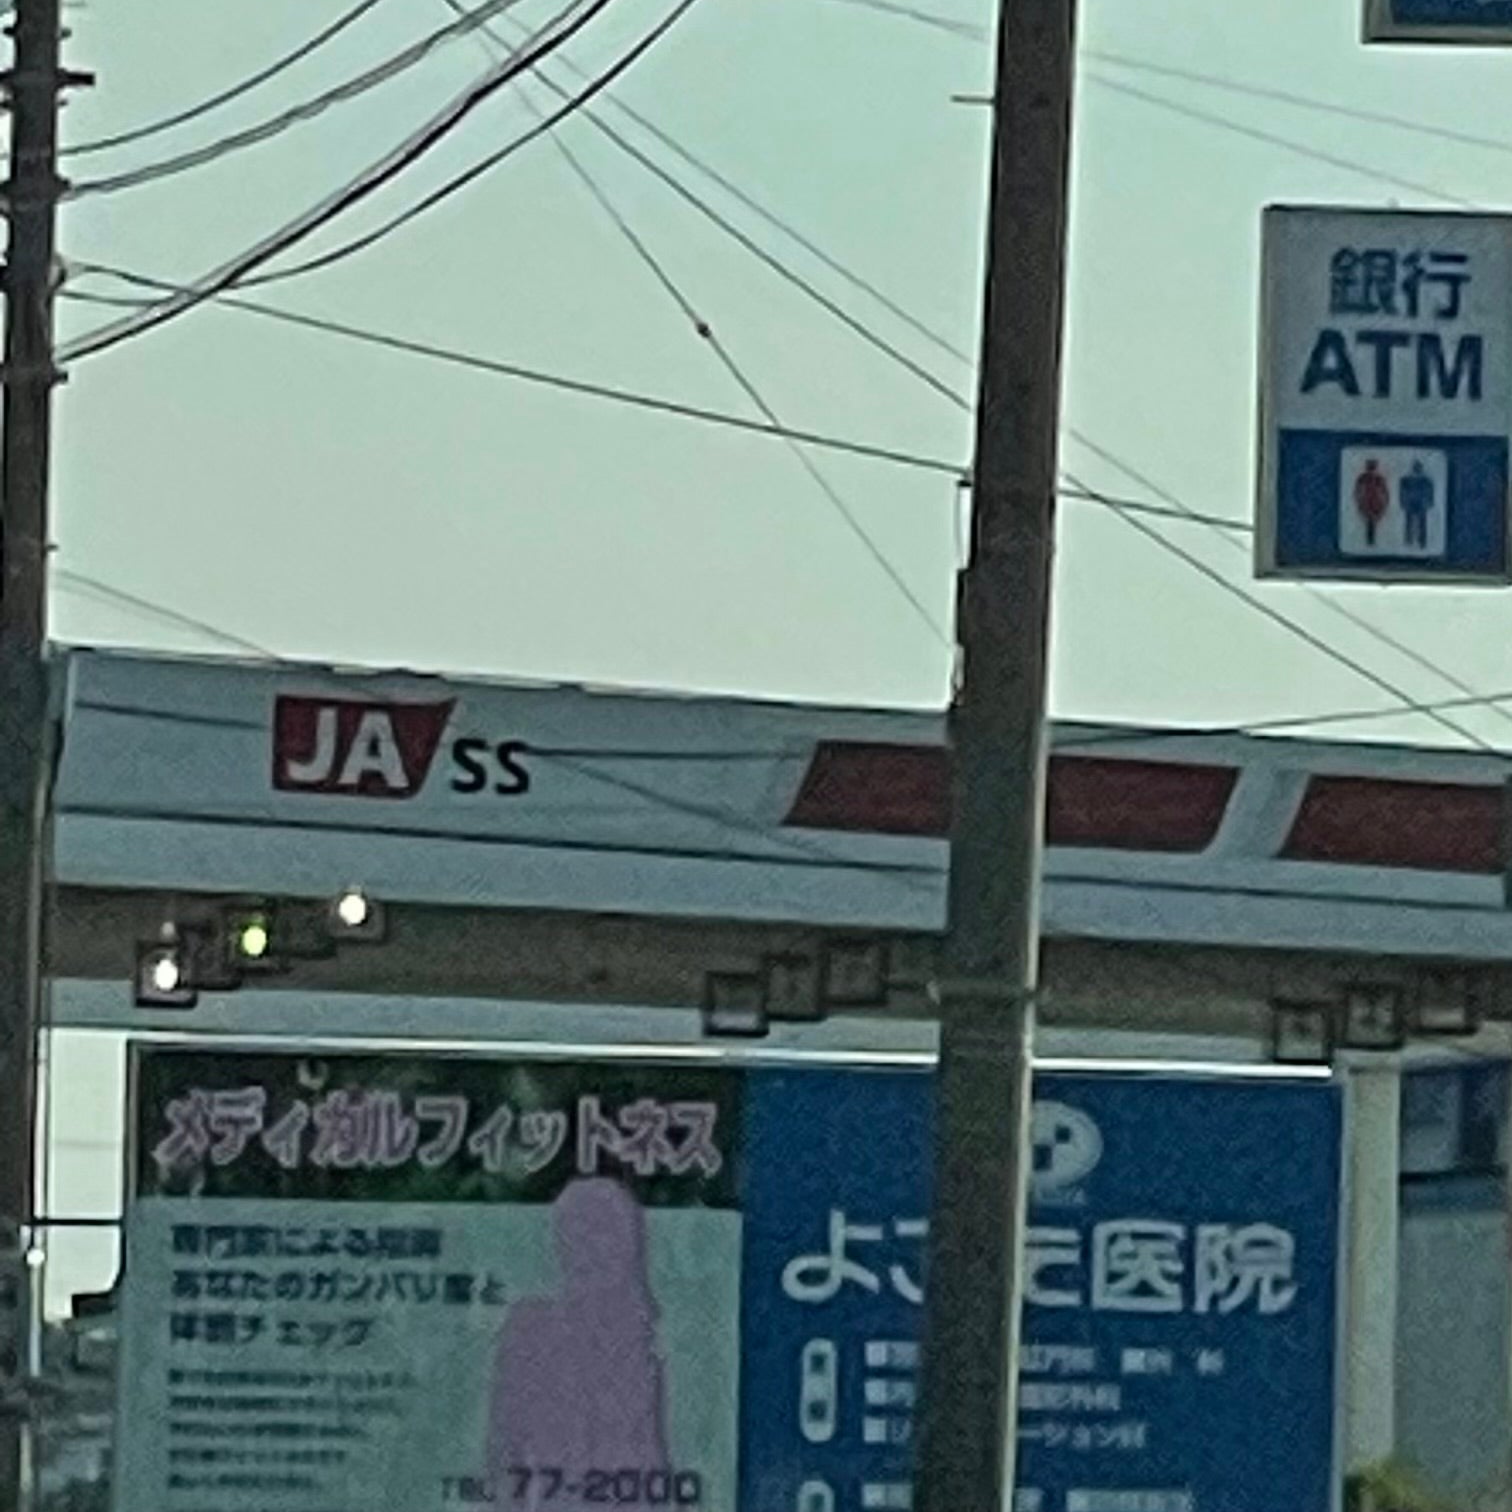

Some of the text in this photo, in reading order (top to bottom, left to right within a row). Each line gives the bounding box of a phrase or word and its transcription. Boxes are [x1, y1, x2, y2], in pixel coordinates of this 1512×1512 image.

[1330, 246, 1471, 320] 銀行
[1300, 329, 1483, 401] ATM
[286, 708, 410, 788] JA
[154, 1085, 724, 1178] メディカルフィットネス
[507, 1466, 703, 1506] 77-2000
